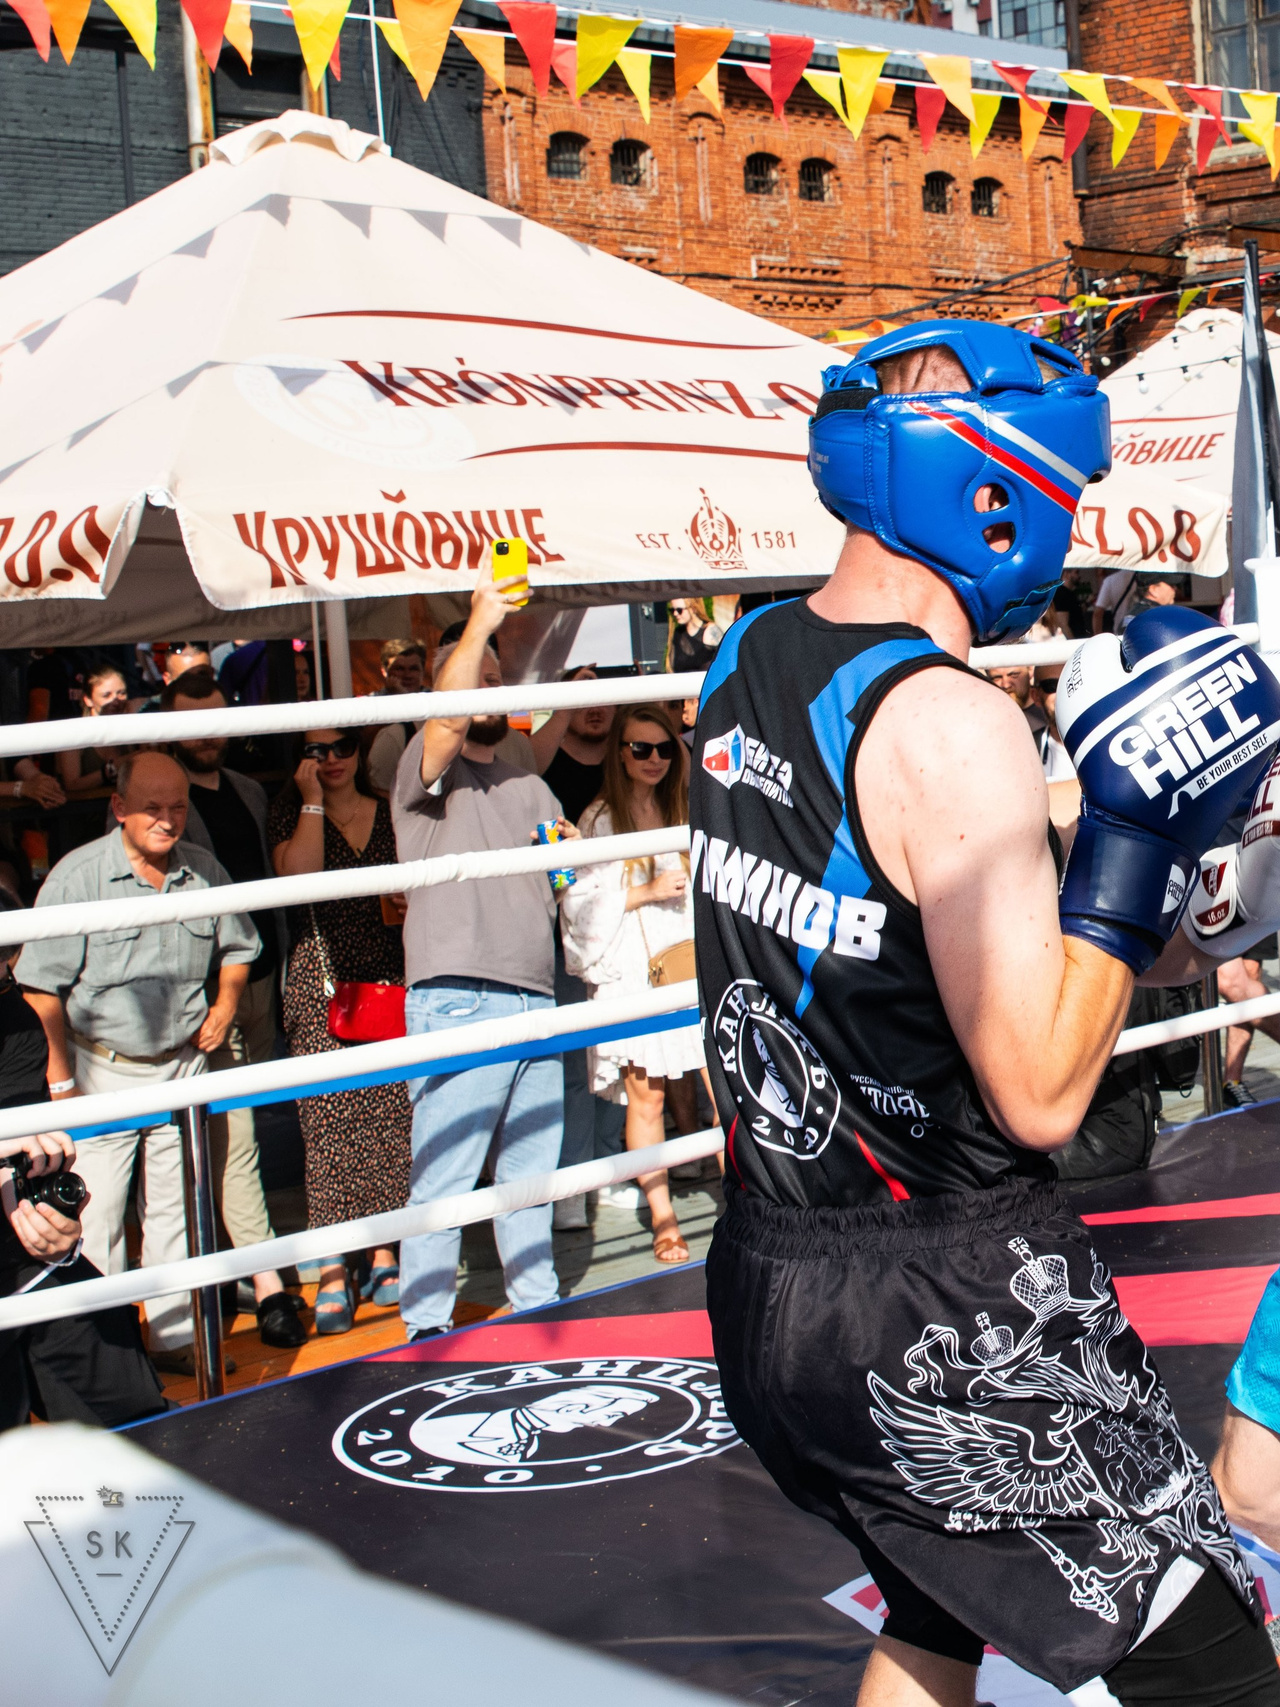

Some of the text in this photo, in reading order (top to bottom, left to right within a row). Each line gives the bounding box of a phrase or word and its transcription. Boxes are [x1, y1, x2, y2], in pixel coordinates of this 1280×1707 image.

[635, 533, 681, 550] EST.
[751, 531, 797, 549] 1581
[1109, 653, 1258, 767] GREEN
[1128, 698, 1261, 799] HILL
[1196, 731, 1269, 791] BE YOUR BEST SELF
[1167, 886, 1182, 903] HILL
[1168, 879, 1185, 894] GREEN
[357, 1428, 534, 1484] 2010
